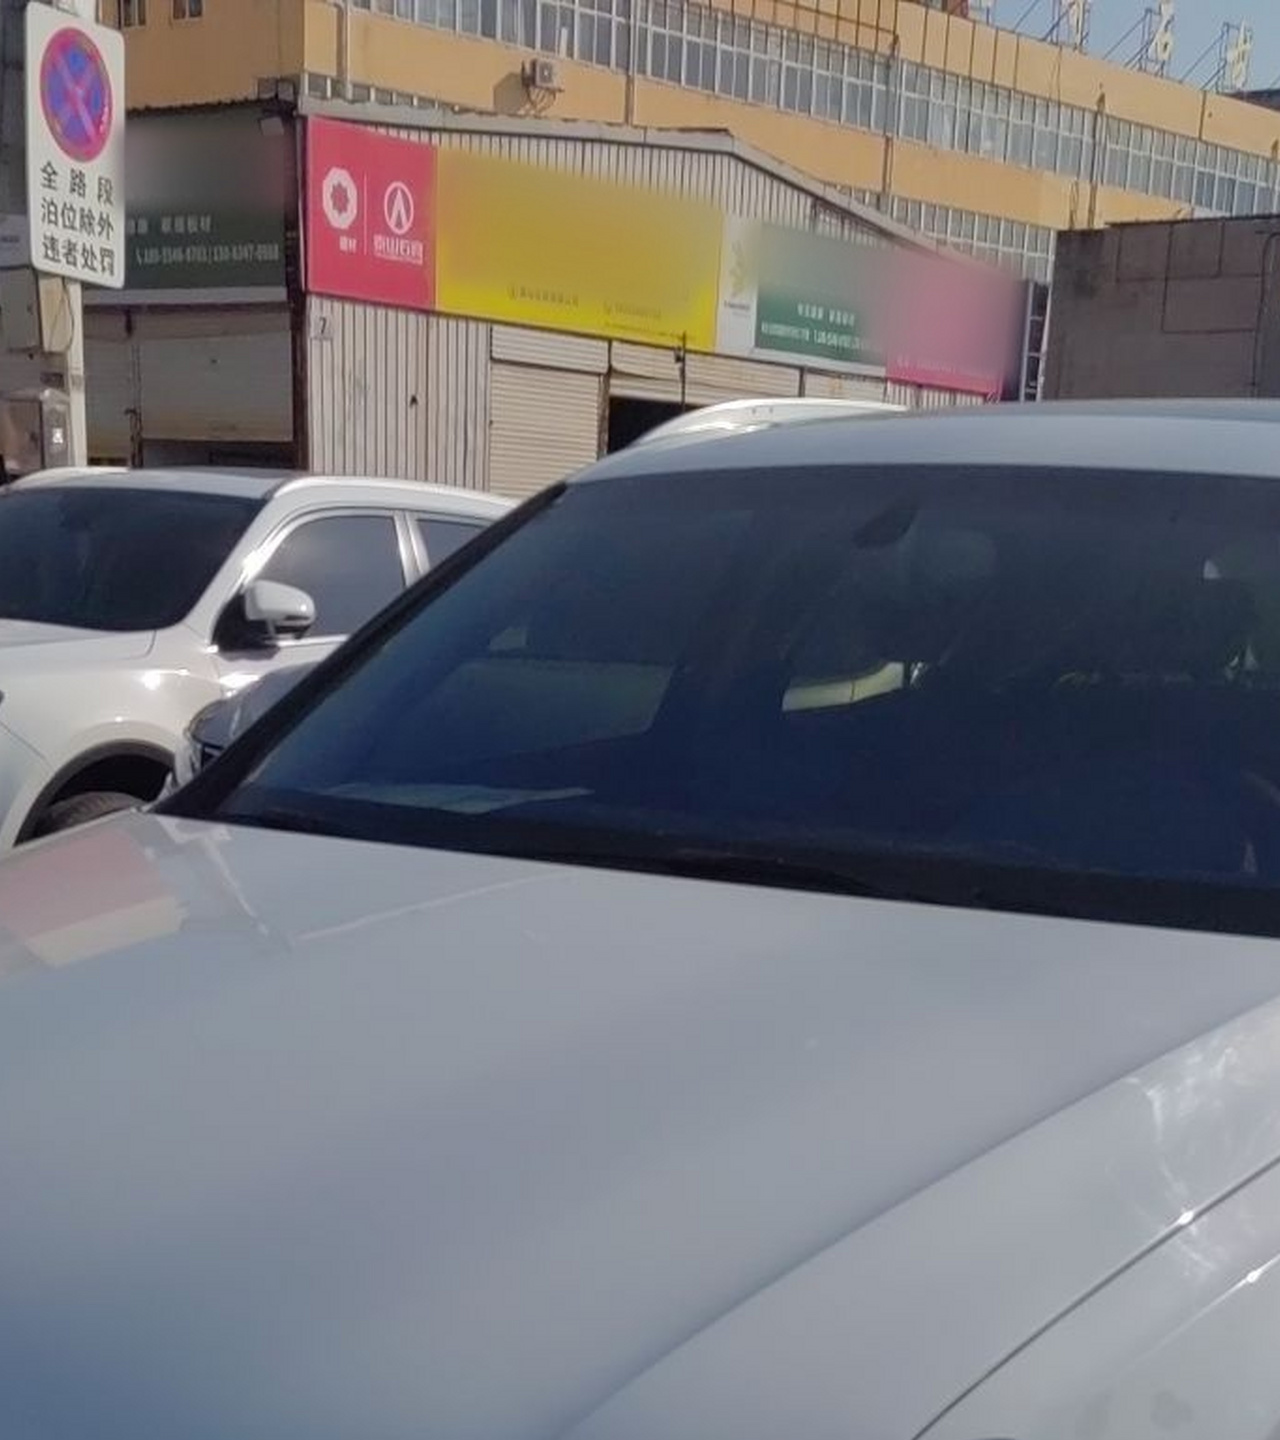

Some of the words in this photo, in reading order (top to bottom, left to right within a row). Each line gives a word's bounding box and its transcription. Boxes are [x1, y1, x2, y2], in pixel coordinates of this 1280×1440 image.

[40, 160, 114, 206] 全路段
[41, 197, 115, 240] 泊位除外
[42, 233, 116, 277] 违者处罚
